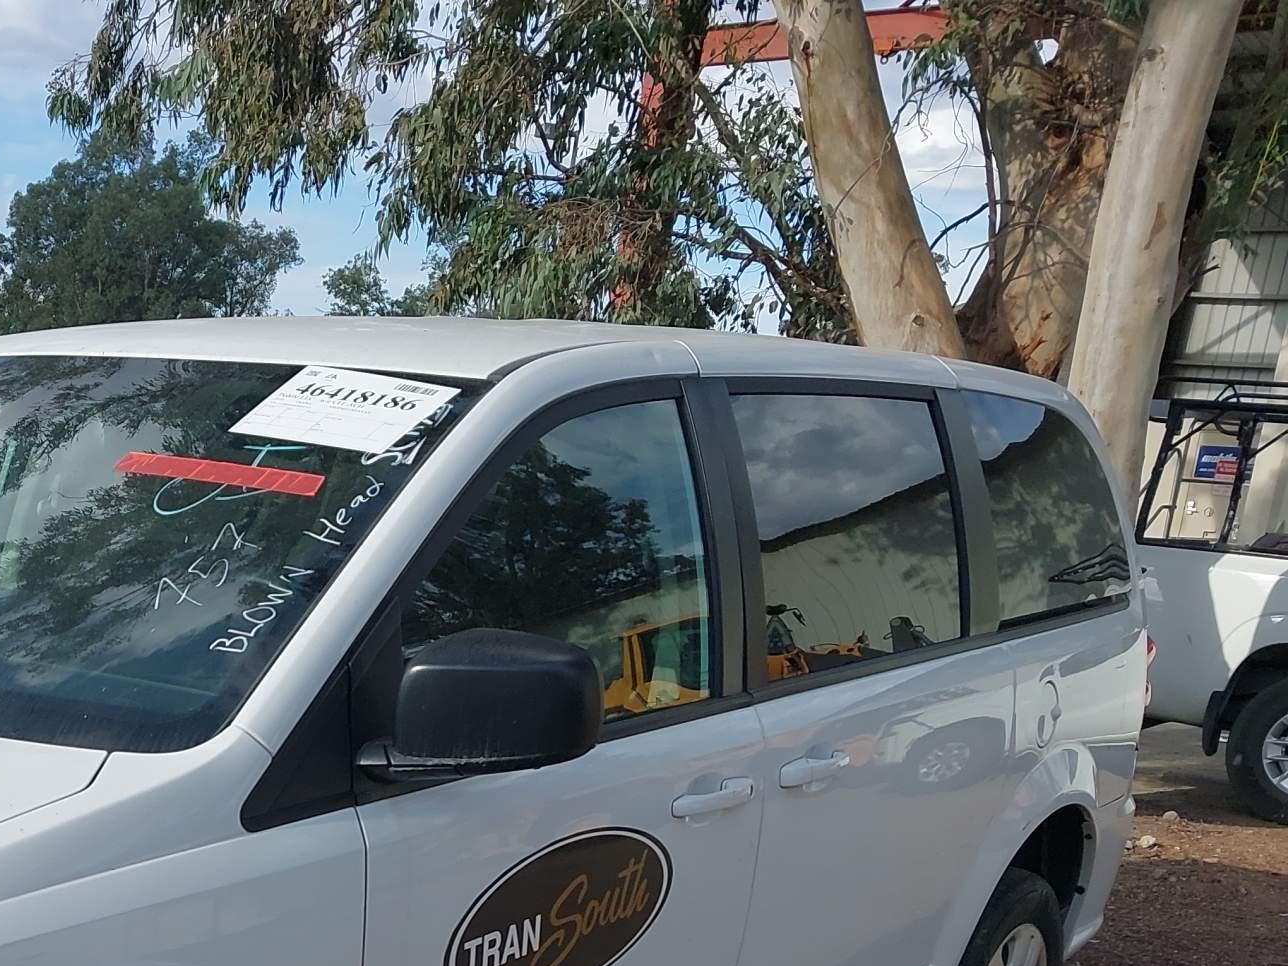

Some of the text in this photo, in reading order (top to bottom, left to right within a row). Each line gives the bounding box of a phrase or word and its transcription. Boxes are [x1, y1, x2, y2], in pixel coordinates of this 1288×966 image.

[295, 382, 419, 412] 46418186
[209, 565, 316, 653] BLOWN
[303, 474, 385, 546] Head
